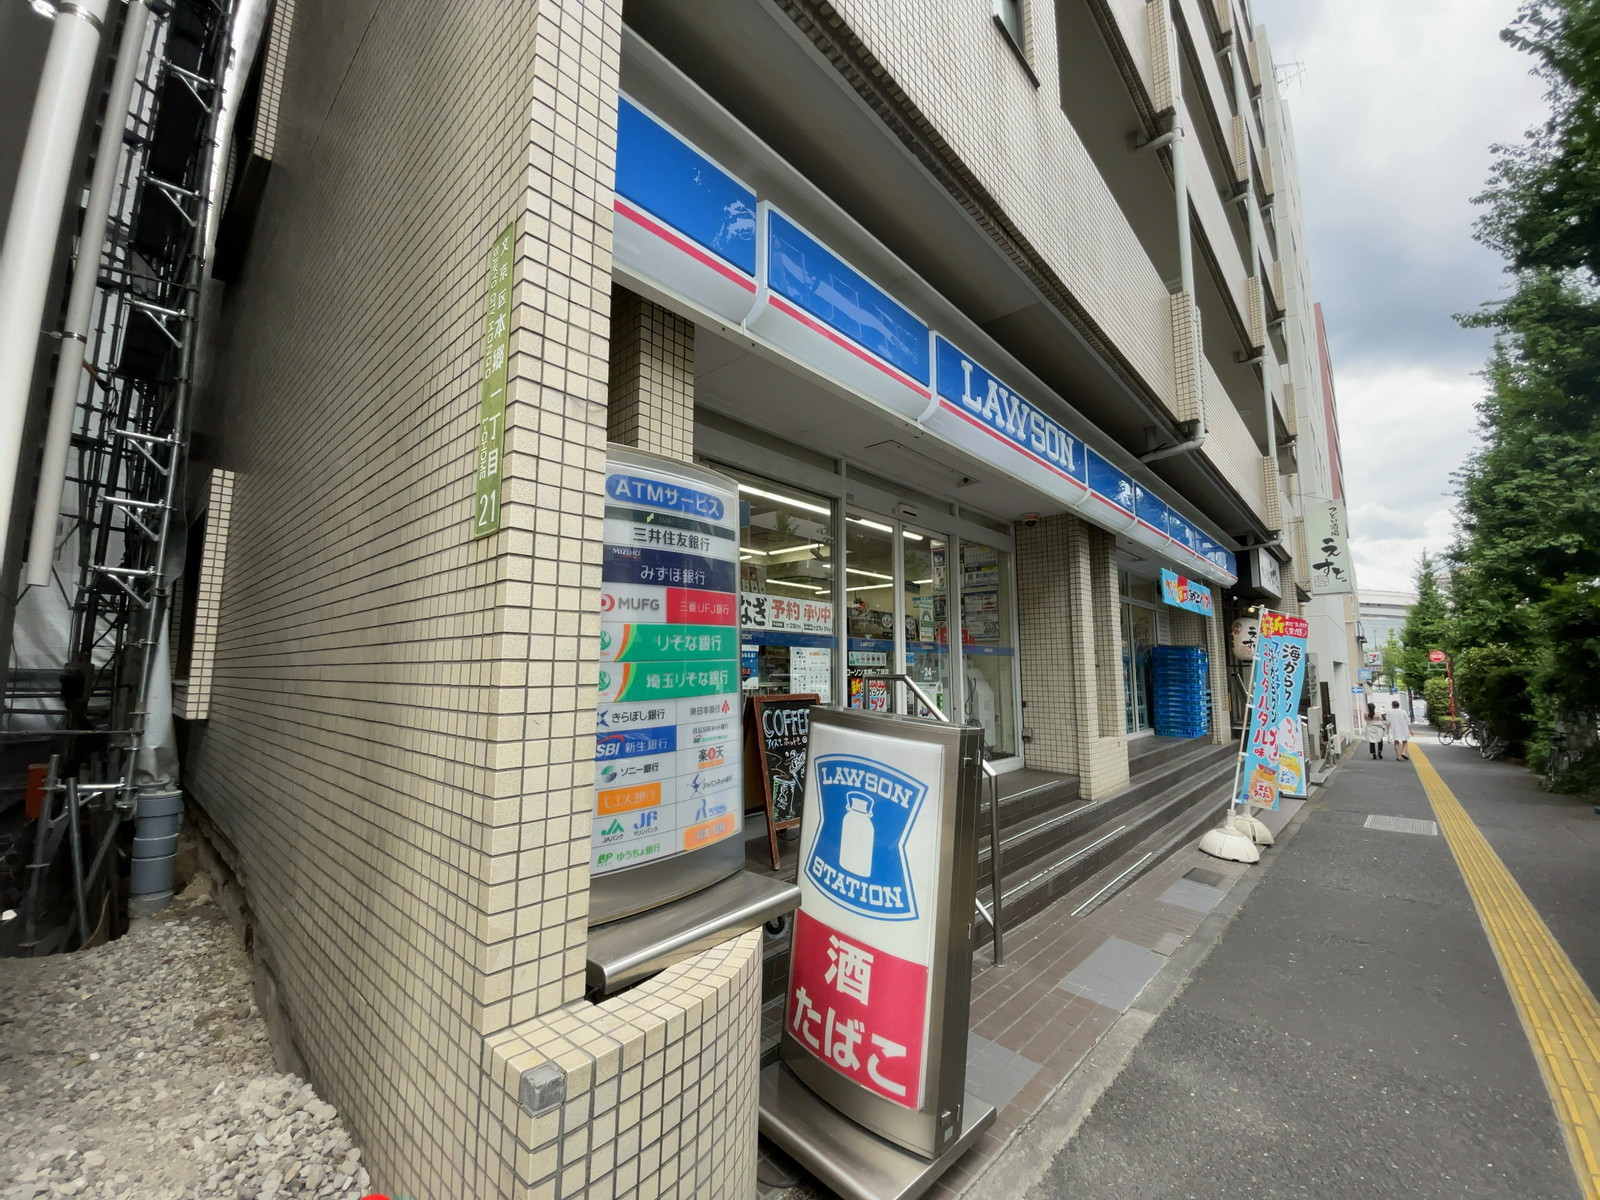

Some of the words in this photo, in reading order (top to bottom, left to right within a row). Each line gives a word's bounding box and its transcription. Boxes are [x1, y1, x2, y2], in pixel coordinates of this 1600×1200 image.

[488, 292, 497, 316] CITY
[484, 320, 495, 380] HONGO
[961, 359, 1076, 473] LAWSON
[479, 416, 489, 481] 1-CHOME
[478, 489, 497, 527] 21
[615, 477, 720, 517] ATMサービス
[633, 526, 711, 553] 三井住友銀行
[611, 547, 641, 558] MIZUHO
[640, 564, 706, 586] みずほ銀行
[618, 597, 660, 611] MUFG
[679, 600, 730, 615] 三菱UFJ銀行
[771, 599, 801, 621] 予約
[803, 603, 831, 624] 承り中
[656, 634, 722, 652] りそな銀行
[646, 669, 728, 689] 埼玉りそな銀行
[612, 708, 666, 724] きらぼし銀行
[596, 743, 620, 757] SBI
[625, 738, 667, 754] 新生銀行
[621, 762, 660, 777] ソニー銀行
[604, 789, 655, 808] じぶん銀行
[820, 766, 914, 809] LAWSON
[602, 833, 624, 844] JAバンク
[633, 827, 658, 837] マリンバンク
[616, 843, 661, 862] ゆうちょ銀行
[811, 856, 905, 909] STATION
[824, 934, 875, 1006] 酒
[792, 986, 907, 1096] たばこ
